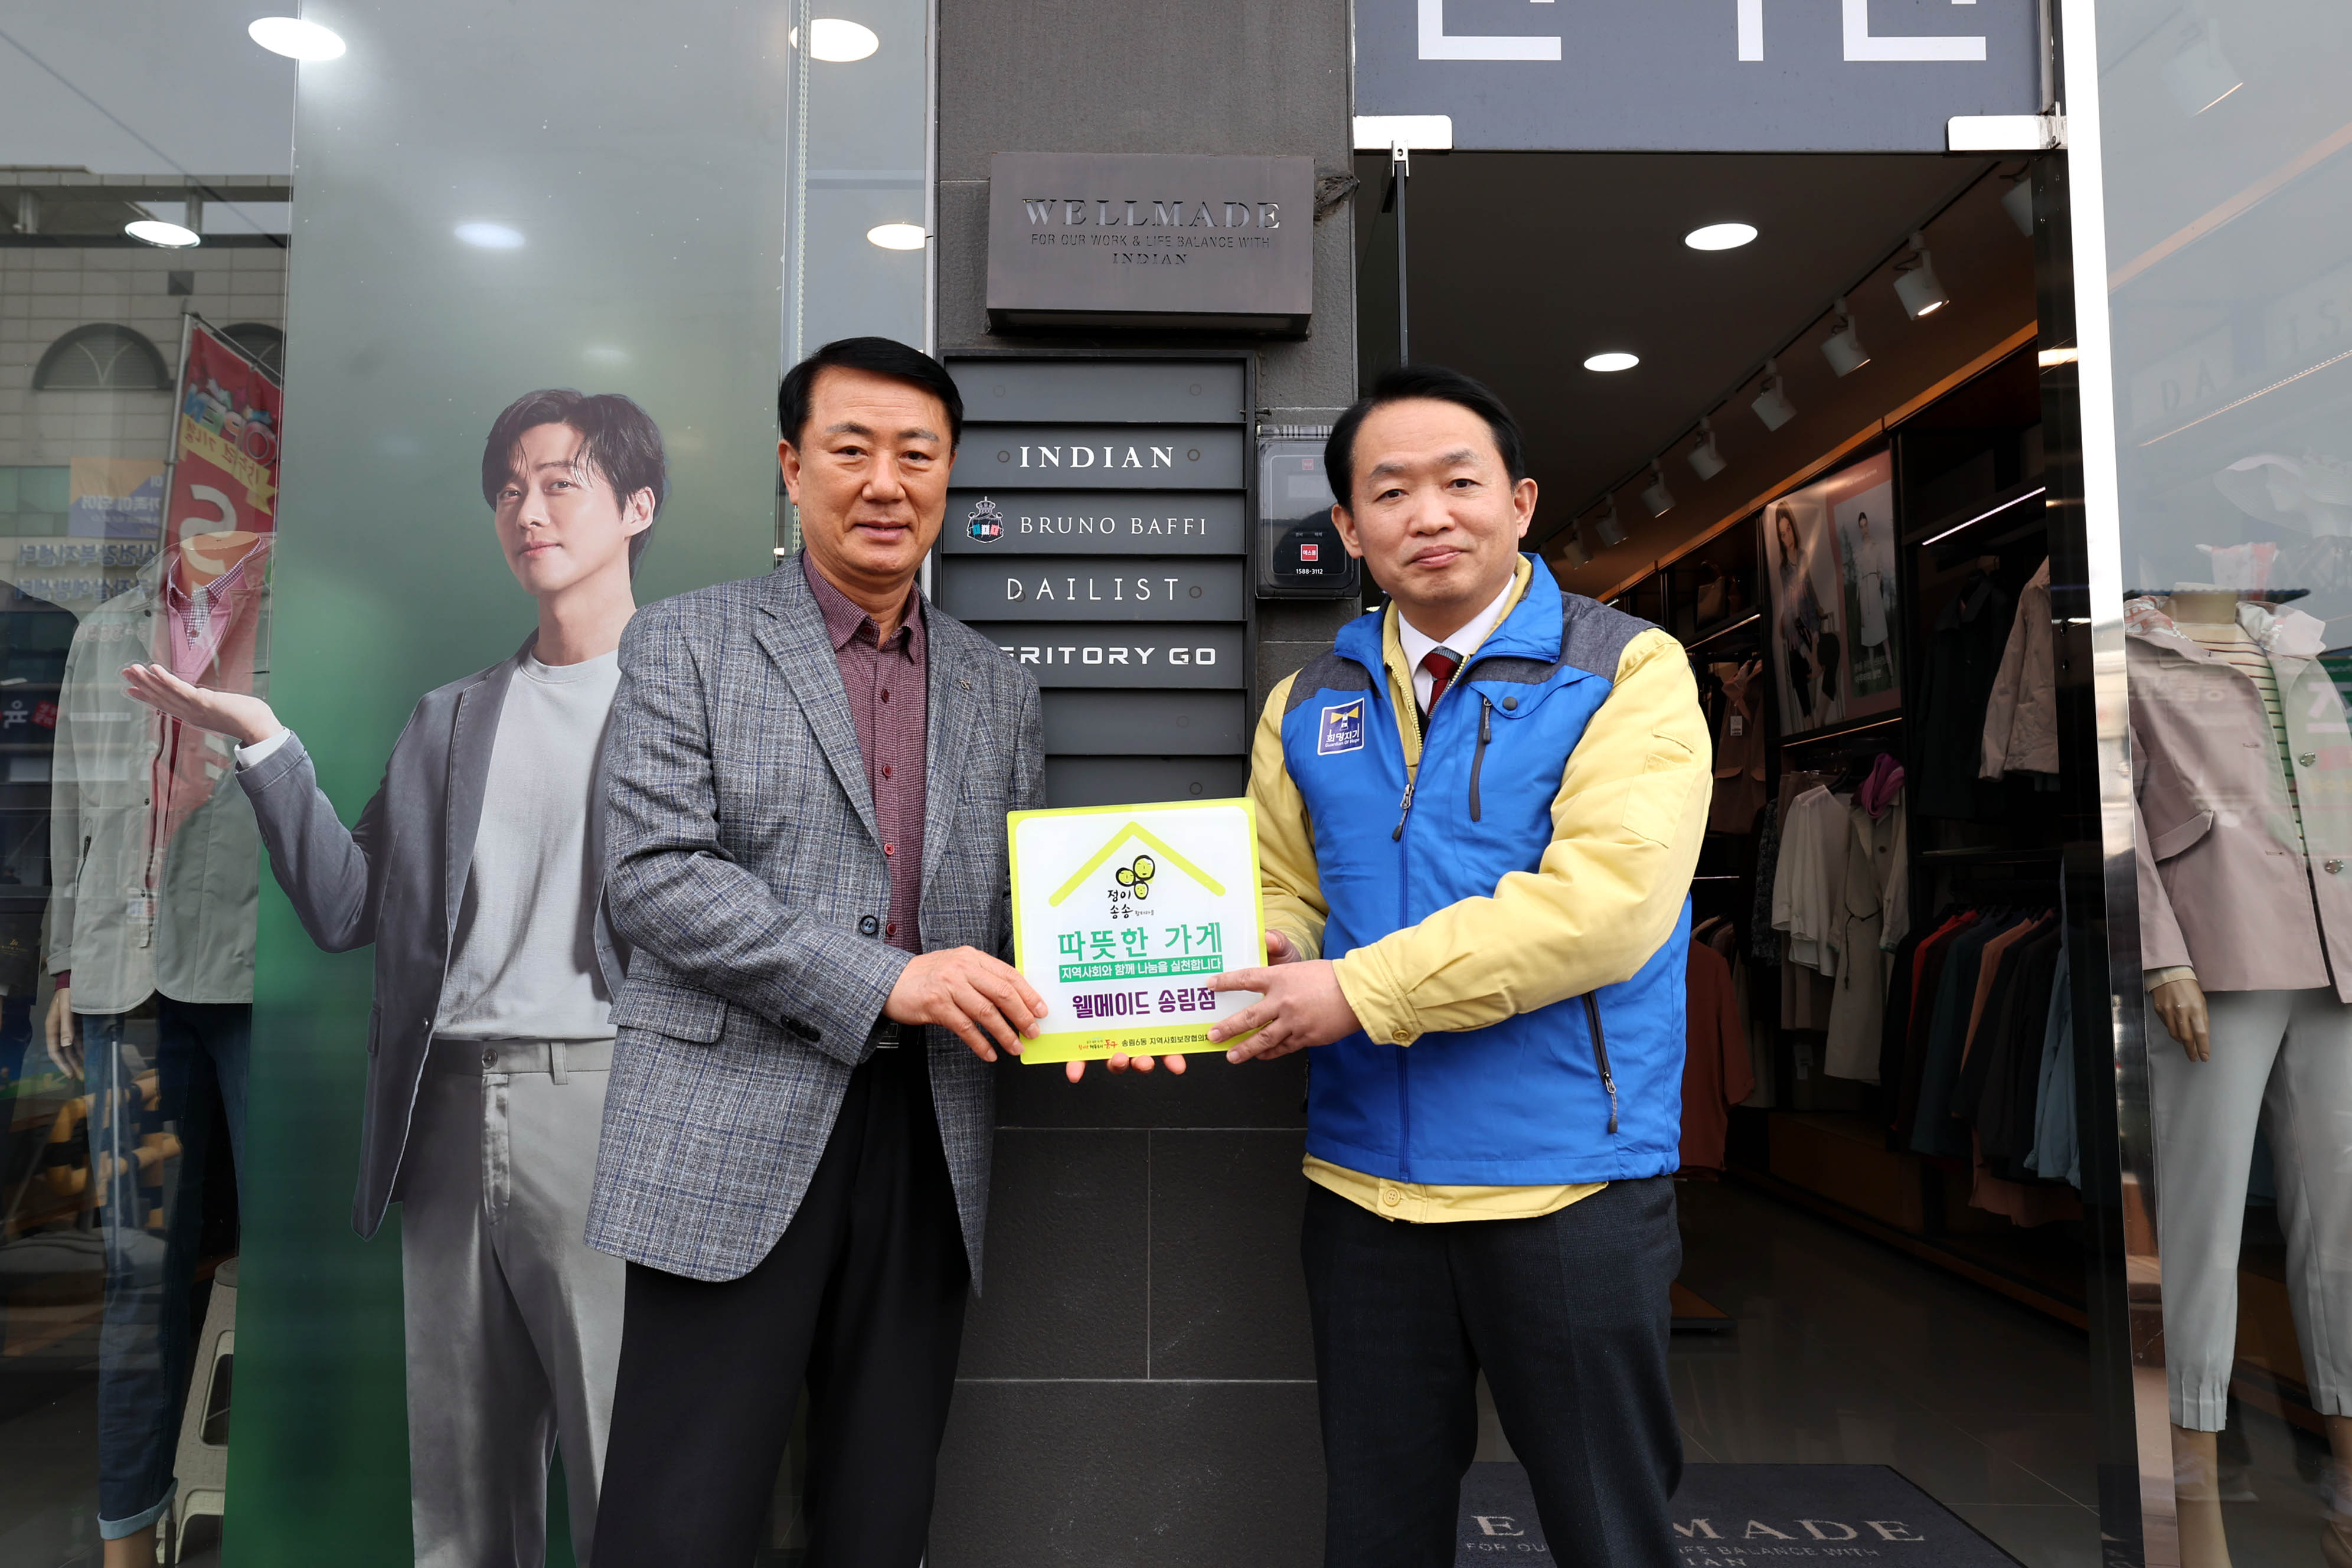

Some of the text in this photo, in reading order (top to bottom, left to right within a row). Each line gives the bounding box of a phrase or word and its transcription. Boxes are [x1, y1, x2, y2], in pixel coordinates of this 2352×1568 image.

[1022, 198, 1281, 229] WELLMADE
[1031, 234, 1270, 249] FOR OUR WORK & LIFE BALANCE WITH
[1112, 253, 1188, 266] INDIAN
[1020, 446, 1174, 468] INDIAN
[1020, 517, 1206, 535] BRUNO BAFFI
[1007, 578, 1178, 601] DAILIST
[1169, 647, 1216, 665] GO
[1326, 723, 1360, 742] 희망지기
[1107, 889, 1132, 902] 정이
[1110, 903, 1133, 919] 송송
[1057, 922, 1223, 961] 따뜻한 가게
[1061, 958, 1221, 980] 지역사회와 함께 나눔을 실천합니다
[1073, 986, 1216, 1019] 웰메이드 송림점
[1122, 1038, 1147, 1047] 송림6동
[1466, 1543, 1880, 1557] FOR OU IFE BALANCE WITH
[1686, 1557, 1747, 1567] IAN
